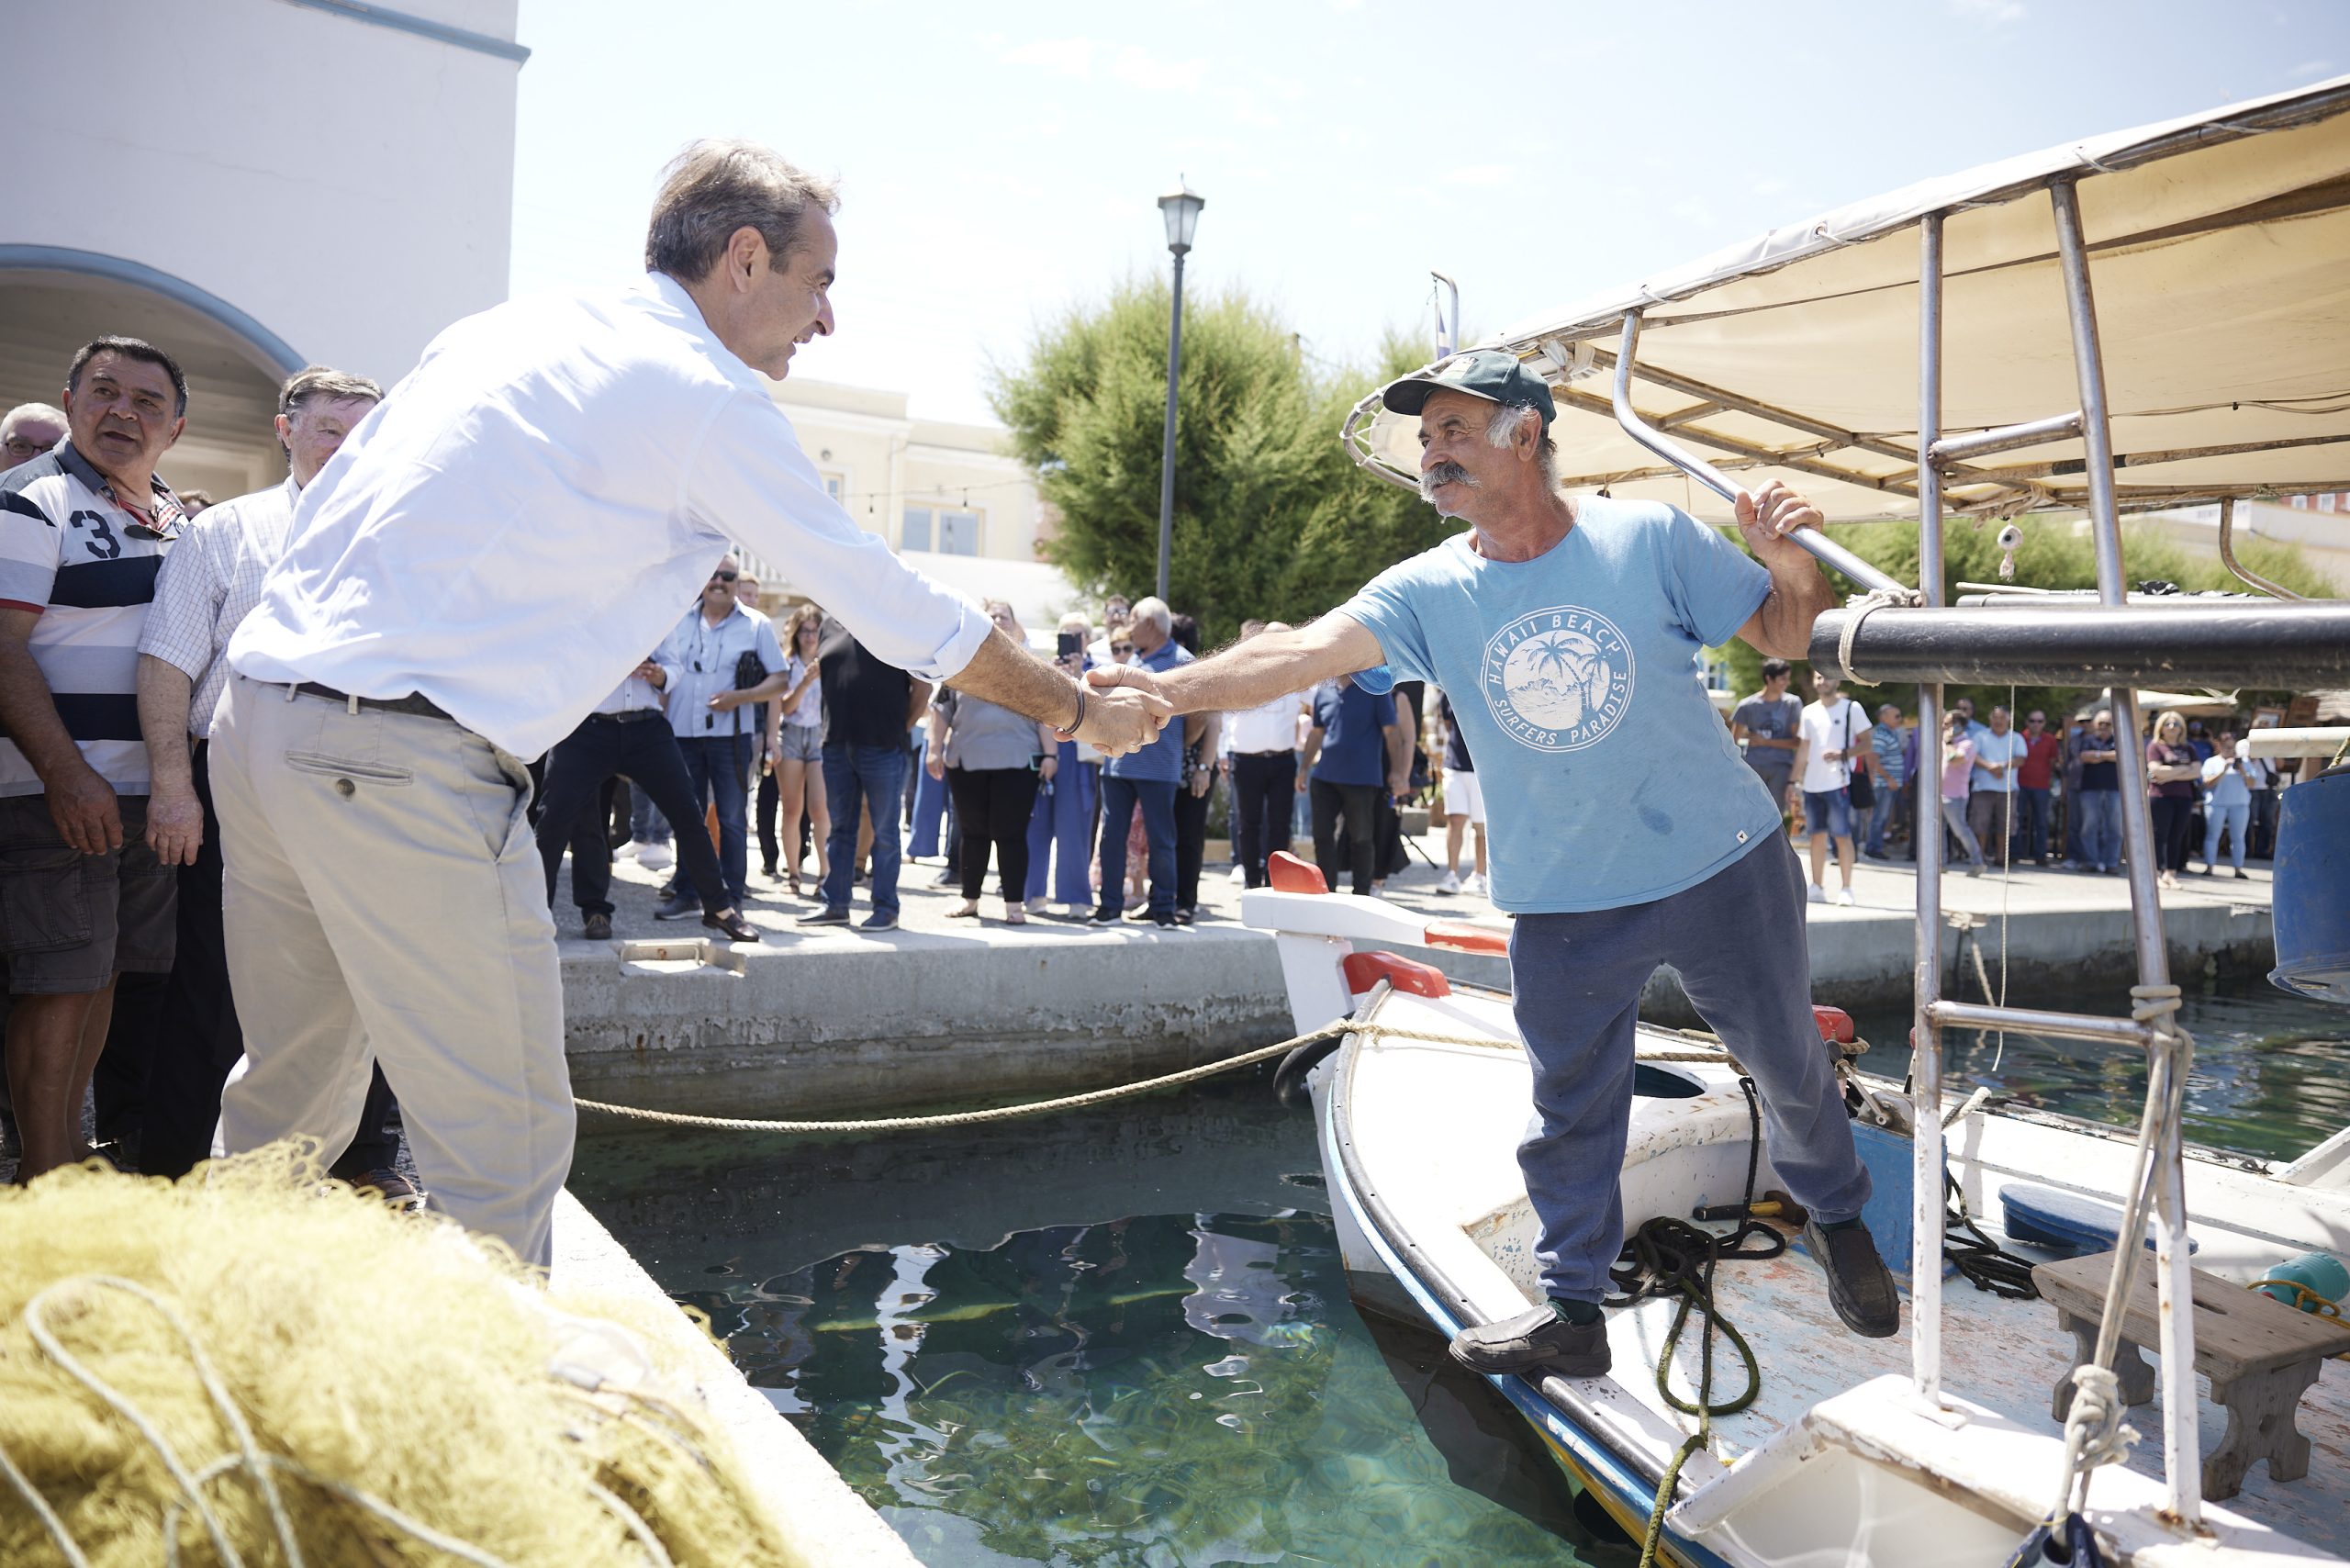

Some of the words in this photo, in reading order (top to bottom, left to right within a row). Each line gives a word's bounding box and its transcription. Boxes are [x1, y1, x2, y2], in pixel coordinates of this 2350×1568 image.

[70, 510, 121, 559] 3
[1489, 621, 1538, 685] HAWAII
[1552, 614, 1621, 653] BEACH
[1494, 699, 1558, 745] SURFERS
[1571, 671, 1628, 744] PARADISE
